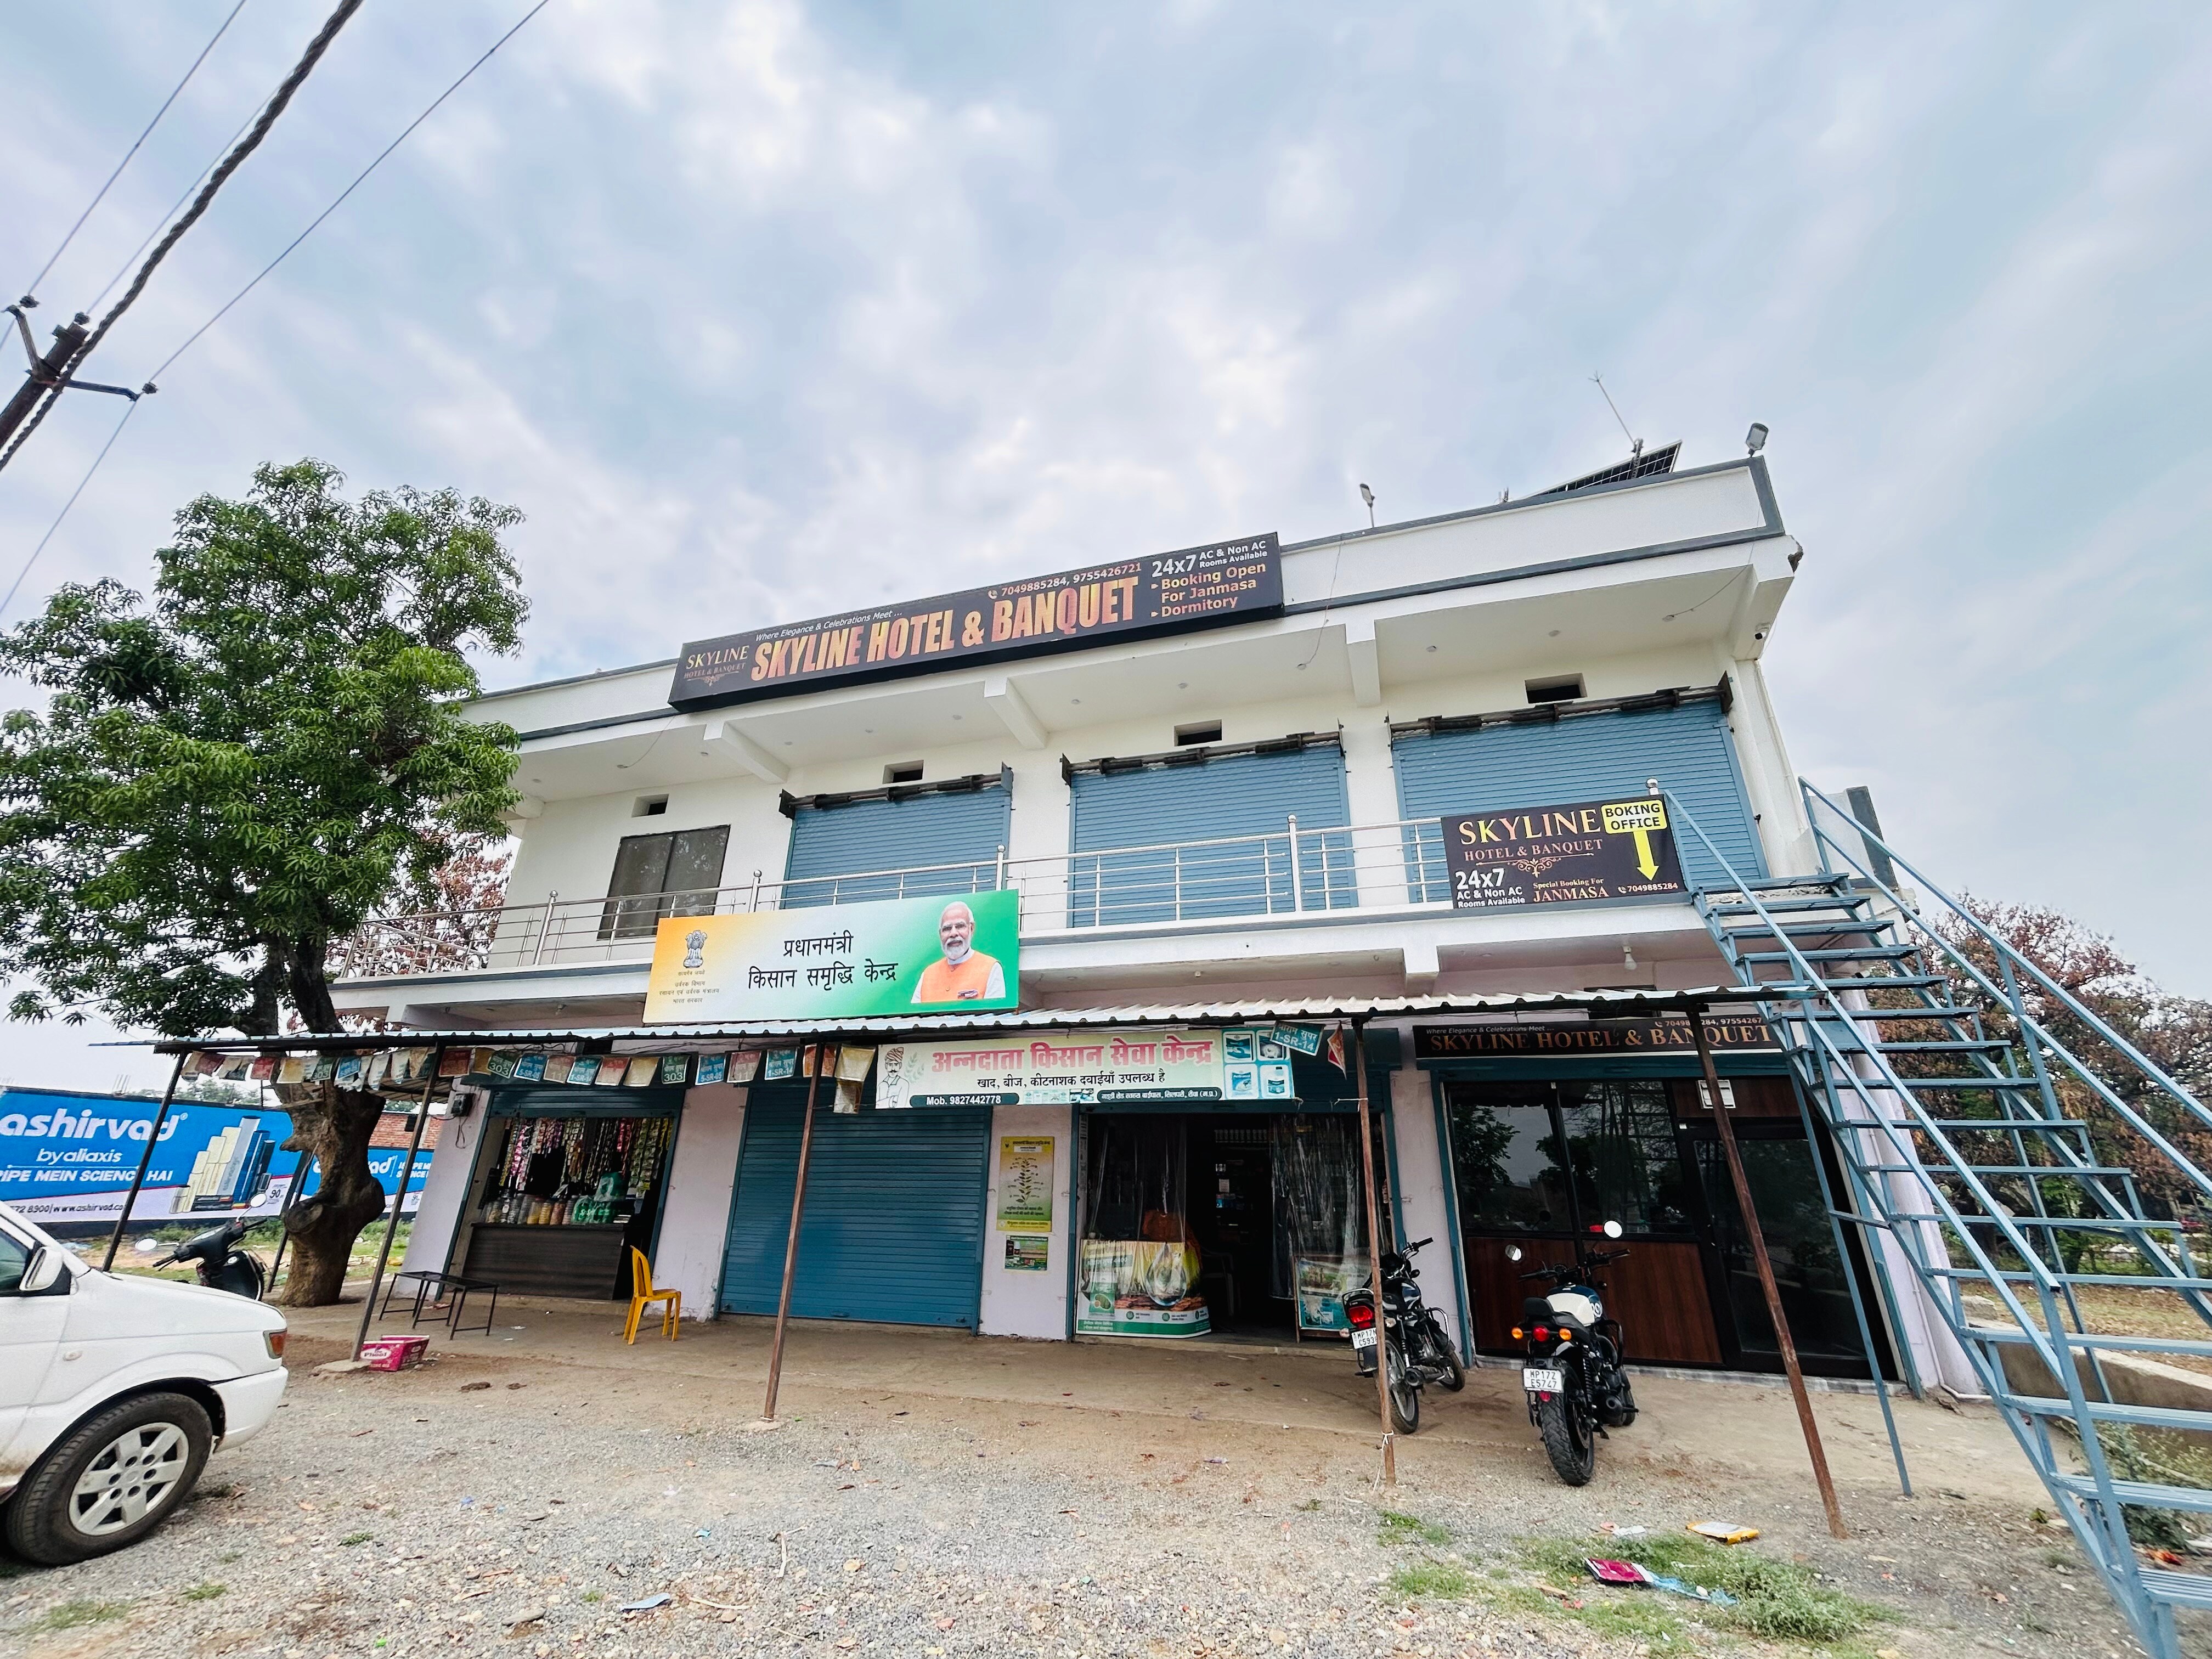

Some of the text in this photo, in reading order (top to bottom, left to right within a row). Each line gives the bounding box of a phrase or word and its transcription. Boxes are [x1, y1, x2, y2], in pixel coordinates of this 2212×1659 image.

[1199, 540, 1266, 560] AC & Non AC
[1199, 550, 1268, 569] Rooms Available
[1152, 554, 1197, 578] 24x7
[1001, 563, 1142, 597] 7049885284, 9755426721
[1161, 563, 1266, 590] Booking Open
[1161, 579, 1257, 603] For Janmasa
[1161, 595, 1238, 618] Dormitory
[751, 576, 1139, 682] SKYLINE HOTEL & BANQUET
[755, 631, 779, 642] Where
[781, 625, 814, 638] Elegance
[823, 614, 871, 629] Celebrations
[872, 610, 893, 622] Meet
[686, 645, 750, 670] SKYLINE
[684, 669, 706, 679] HOTEL
[714, 662, 746, 675] BANQUET
[1605, 803, 1661, 818] BOKING
[1459, 809, 1601, 846] SKYLINE
[1611, 817, 1661, 831] OFFICE
[1464, 838, 1603, 861] HOTEL & BANQUET
[1454, 868, 1505, 890] 24x7
[1533, 877, 1604, 890] Special Booking For
[1627, 882, 1678, 893] 7049885284
[1457, 886, 1523, 900] AC & Non AC
[1458, 895, 1526, 909] Rooms Available
[1533, 887, 1610, 903] JANMASA
[783, 930, 854, 957] प्रधानमंत्री
[748, 958, 899, 991] किसान समृद्धि केन्द्र
[1275, 1031, 1314, 1051] 1-SR-14
[1431, 1024, 1772, 1050] SKYLINE HOTEL & BANQUET
[932, 1035, 1214, 1073] अन्नदाता किसान सेवा केन्द्र
[489, 1062, 509, 1075] 303
[664, 1072, 683, 1081] 303
[768, 1066, 793, 1076] 1-SR-14
[977, 1078, 1000, 1090] खाद,
[1003, 1074, 1027, 1088] बीज,
[1030, 1073, 1076, 1087] कीटनाशक
[1118, 1073, 1155, 1084] उपलब्ध
[1158, 1068, 1166, 1083] है
[926, 1095, 1001, 1105] Mob. 9827442778
[0, 1108, 180, 1141] ashirvad
[63, 1148, 123, 1163] aliaxis
[0, 1170, 173, 1182] IPE MEIN SCIENC HAI
[53, 1204, 126, 1212] www.ashirvad.co
[1531, 1379, 1557, 1389] E5747
